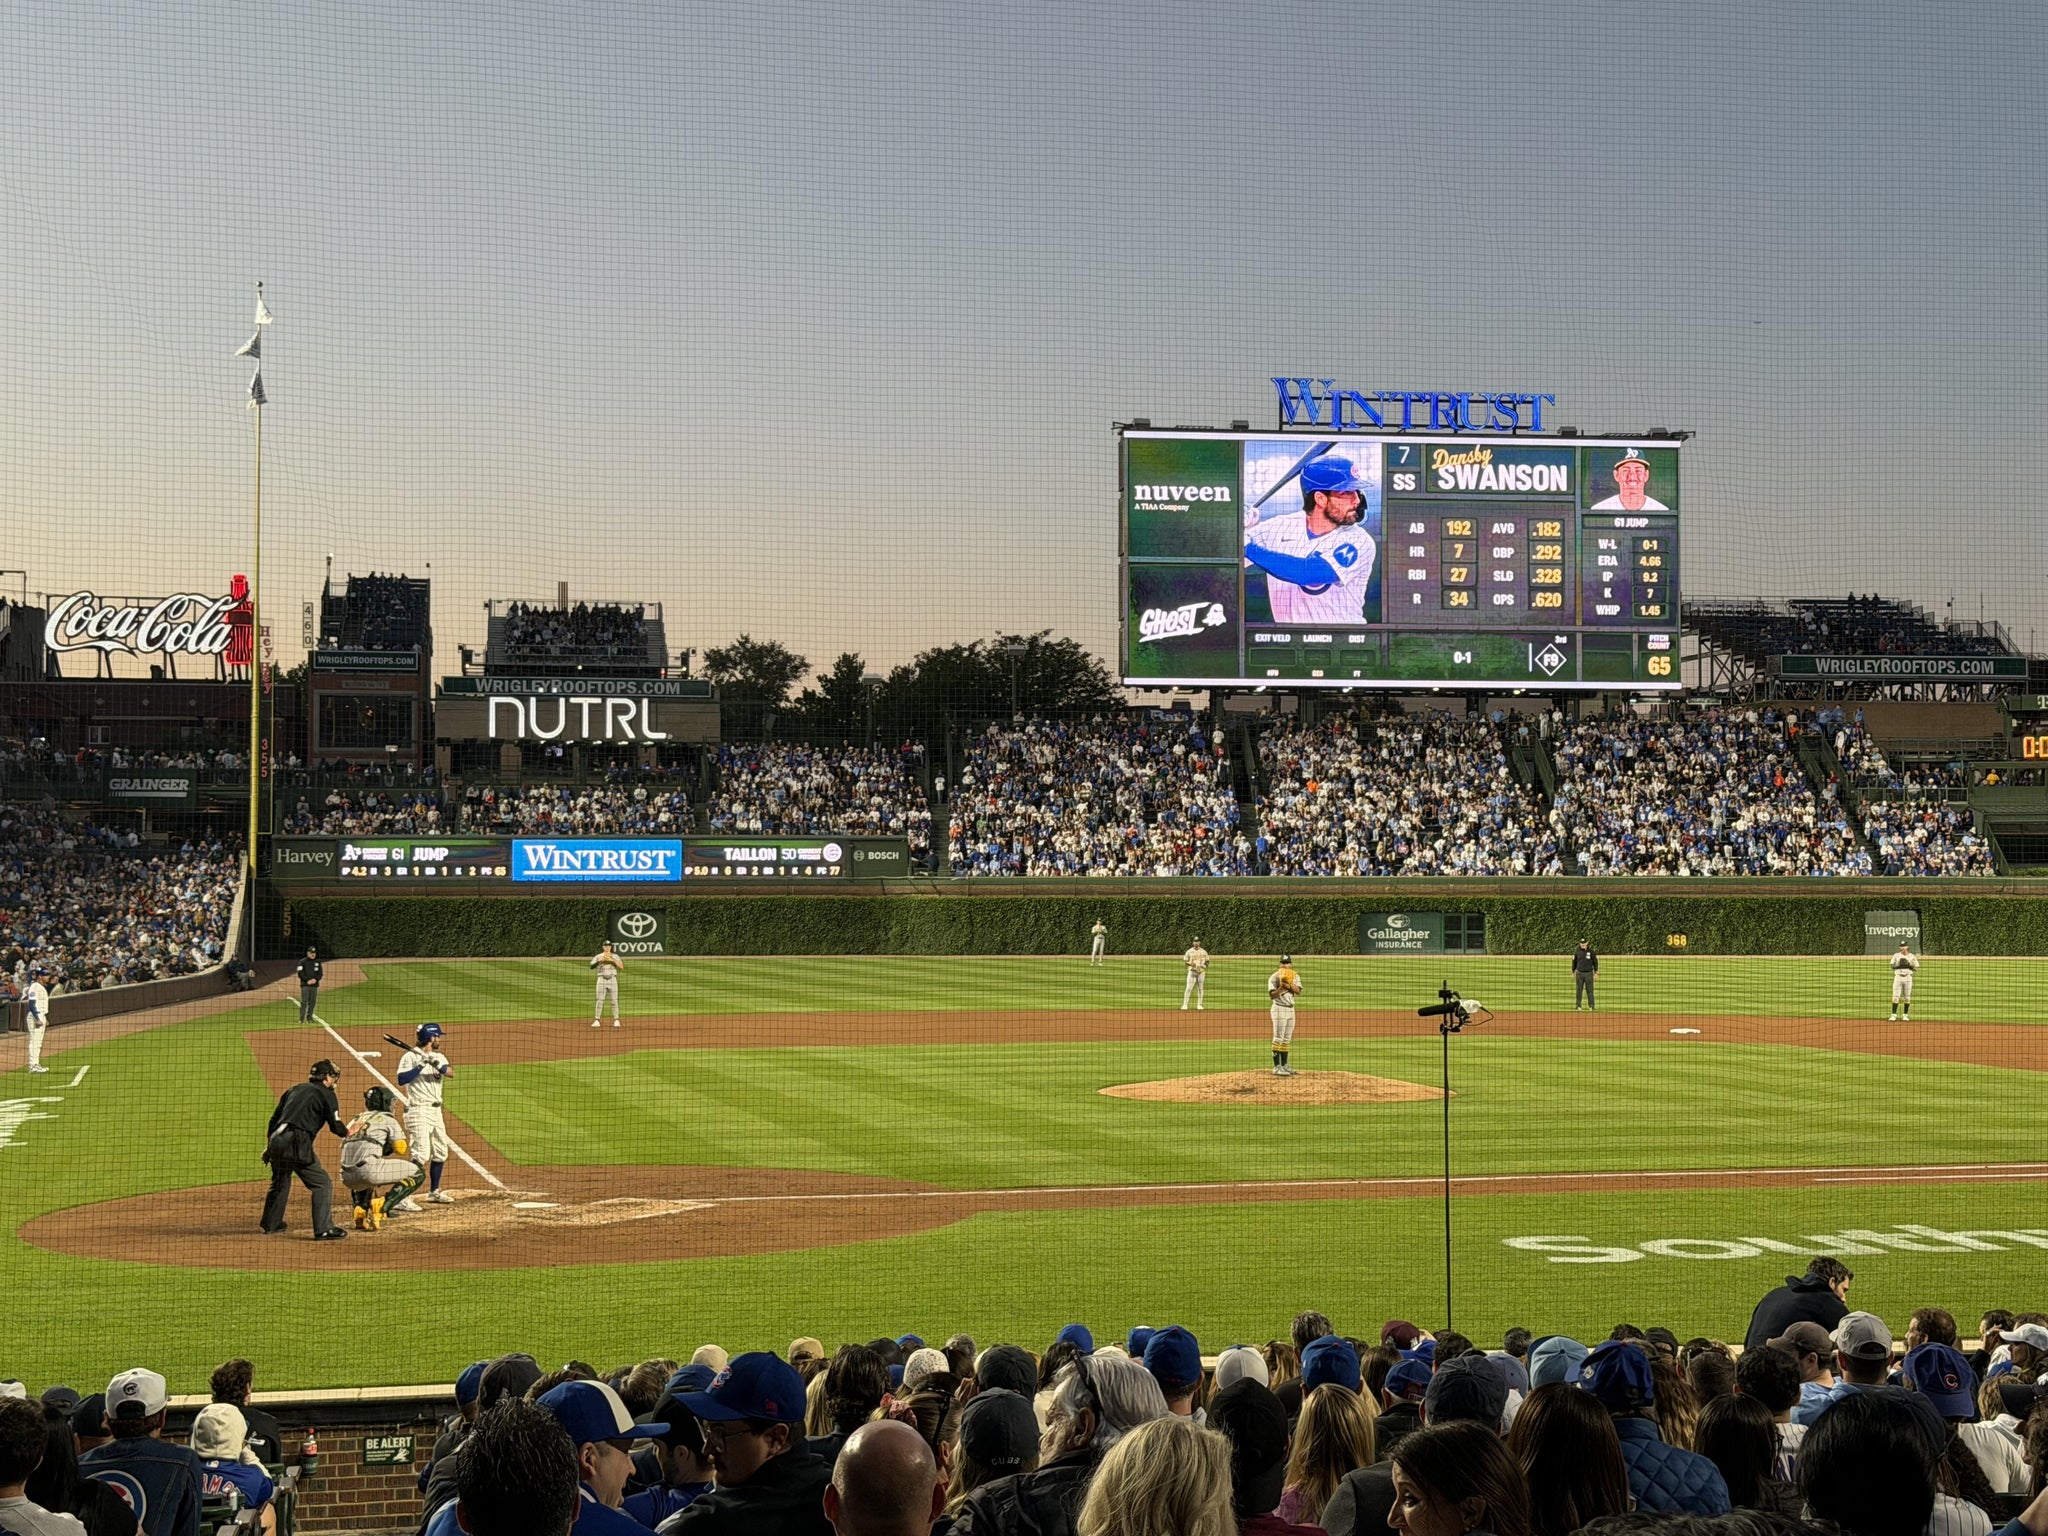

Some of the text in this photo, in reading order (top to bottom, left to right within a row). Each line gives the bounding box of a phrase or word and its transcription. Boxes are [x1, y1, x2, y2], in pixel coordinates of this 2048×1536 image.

[1270, 377, 1556, 432] WINTRUST
[1398, 446, 1410, 464] 7
[1431, 444, 1493, 470] Dansby
[1392, 473, 1416, 491] SS
[1437, 464, 1568, 491] SWANSON
[1134, 484, 1231, 502] nuveen
[1159, 503, 1189, 512] Company
[1409, 520, 1561, 537] AB 192 AVG .182
[1614, 517, 1649, 527] 61 JUMP
[1598, 538, 1658, 550] W-L 0-1
[1409, 543, 1562, 560] HR 7 OBP .292
[1597, 555, 1662, 567] ERA 4.66
[1408, 567, 1562, 584] RBI 27 SLG .328
[1602, 571, 1658, 583] IP 9.2
[1413, 591, 1562, 608] R 34 OPS .620
[1603, 587, 1654, 599] K 7
[1595, 604, 1661, 616] WHIP 1.45
[45, 590, 246, 657] Coca-Cola
[1139, 601, 1212, 642] GHOST
[1255, 633, 1291, 643] EXIT VELO
[1303, 634, 1332, 643] LAUNCH
[1348, 635, 1365, 644] DIST
[1554, 635, 1568, 644] 3rd
[1649, 634, 1669, 642] PITCH
[1647, 641, 1670, 650] COUNT
[317, 655, 415, 665] WRIGLEYROOFTOPS.COM
[1453, 651, 1472, 664] 0-1
[1543, 653, 1560, 667] F9
[1648, 656, 1671, 675] 65
[1815, 658, 1995, 675] WRIGLEYROOFTOPS.COM
[475, 678, 681, 696] WRIGLEYROOFTOPS.COM
[109, 779, 190, 791] GRAINGER
[276, 848, 334, 867] Harvey
[412, 847, 449, 861] JUMP
[723, 847, 797, 861] TAILLON 50
[868, 851, 900, 860] BOSCH
[351, 866, 368, 876] 4.2
[384, 866, 392, 876] 3
[413, 866, 420, 876] 1
[441, 866, 448, 876] 1
[469, 866, 476, 876] 2
[494, 866, 507, 876] 65
[693, 866, 709, 876] 5.0
[724, 865, 732, 876] 6
[751, 865, 759, 876] 2
[779, 865, 785, 876] 1
[804, 865, 812, 876] 4
[829, 866, 841, 876] 77
[1367, 928, 1430, 941] Gallagher
[1864, 924, 1920, 938] Invenergy
[1375, 941, 1422, 949] INSURANCE
[1666, 934, 1688, 947] 368
[612, 942, 663, 953] TOYOTA
[366, 1436, 413, 1450] BE ALERT
